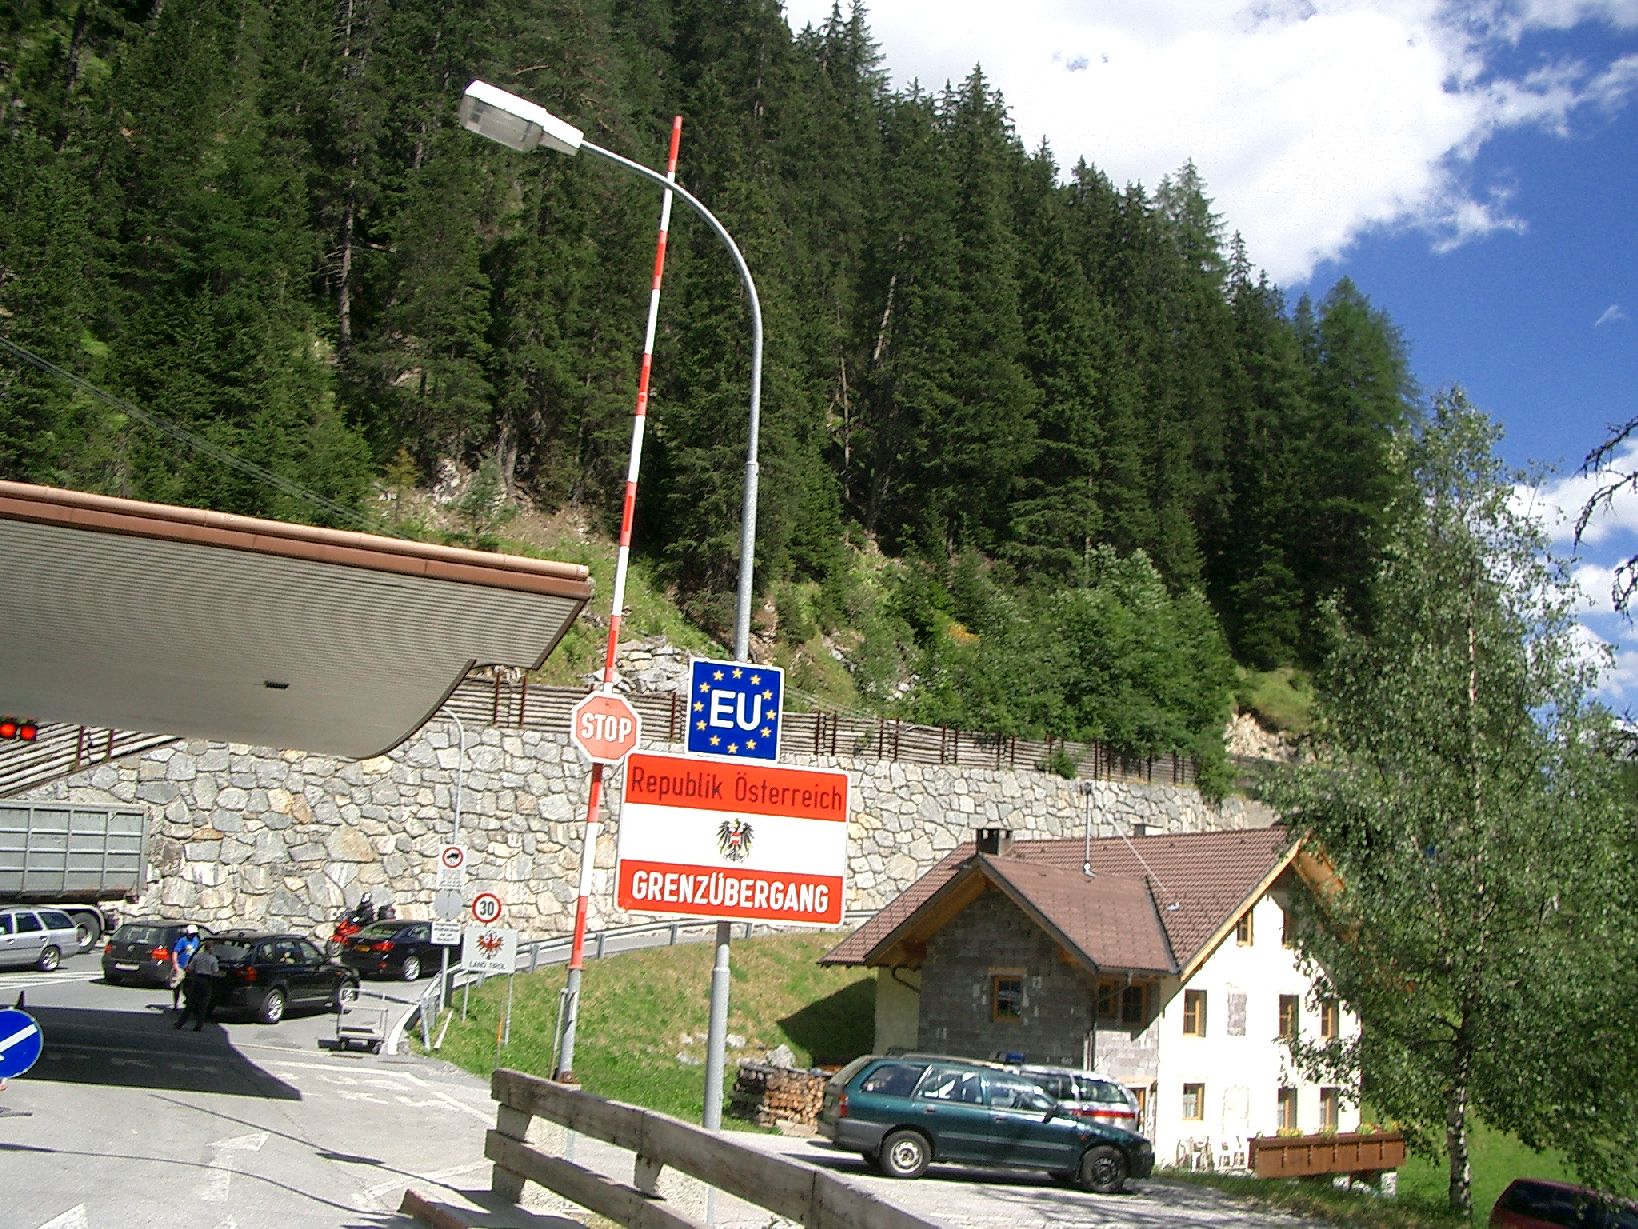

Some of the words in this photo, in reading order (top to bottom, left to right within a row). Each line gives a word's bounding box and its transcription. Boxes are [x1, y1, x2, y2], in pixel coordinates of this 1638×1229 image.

[581, 713, 632, 743] STOP
[709, 689, 762, 731] EU
[631, 767, 723, 801] Republik
[735, 772, 843, 811] Österreich
[479, 901, 495, 916] 30
[632, 870, 829, 913] GRENZÜBERGANG
